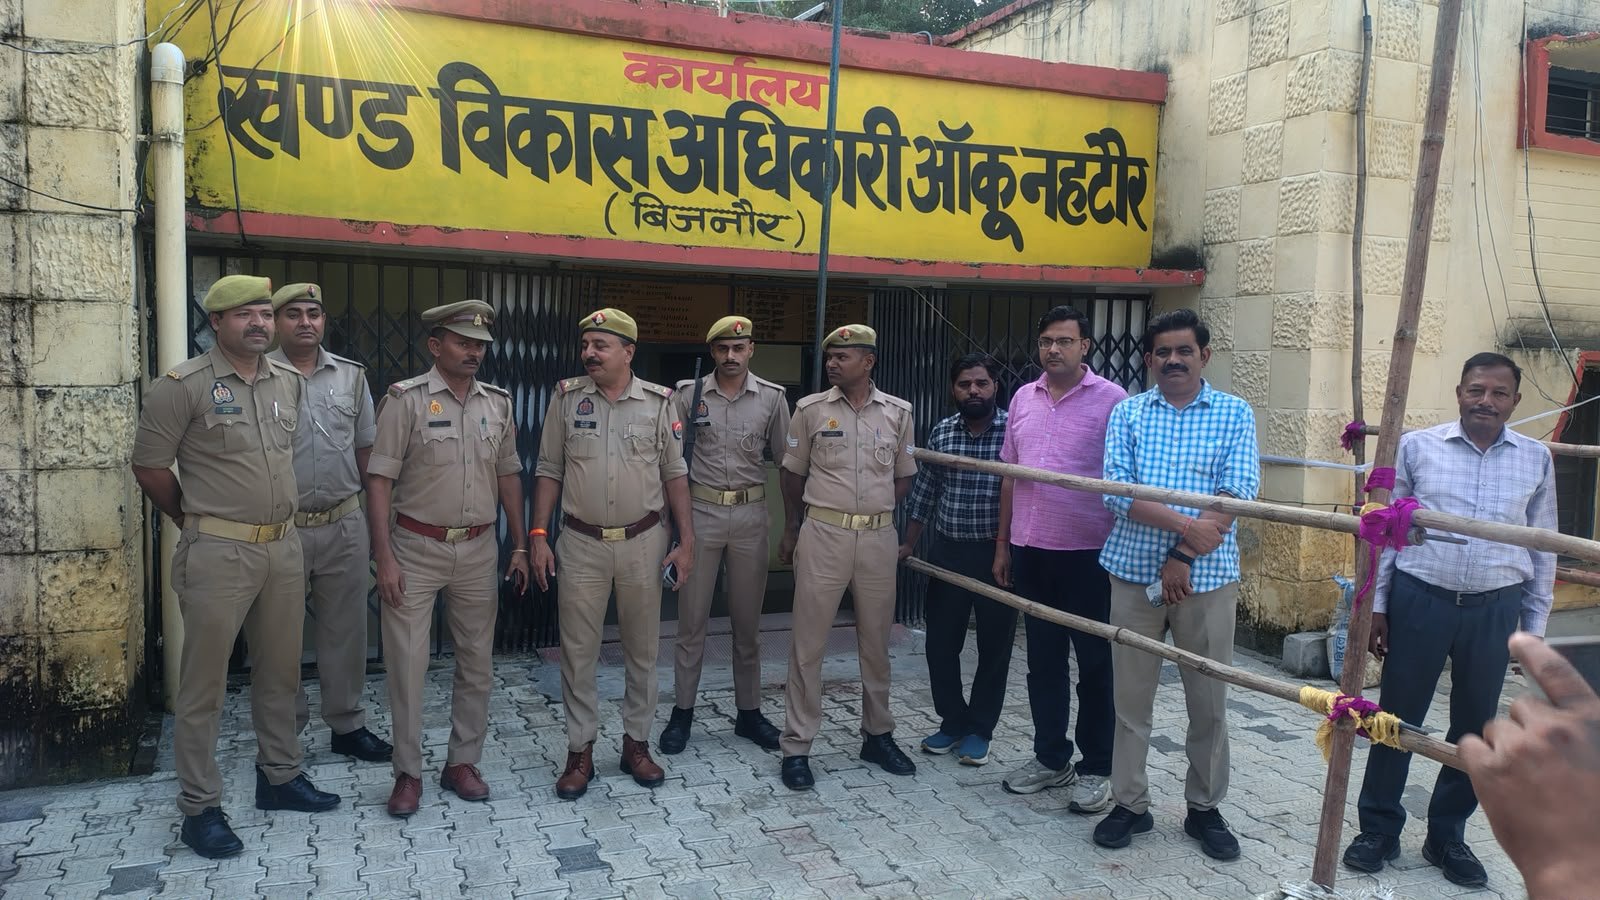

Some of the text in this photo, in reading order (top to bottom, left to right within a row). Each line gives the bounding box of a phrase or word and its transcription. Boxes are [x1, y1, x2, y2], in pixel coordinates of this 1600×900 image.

[622, 51, 830, 112] कार्यालय
[217, 65, 424, 171] खण्ड
[428, 61, 658, 194] विकास
[656, 100, 912, 213] अधिकारी
[1019, 127, 1150, 232] नहटौर
